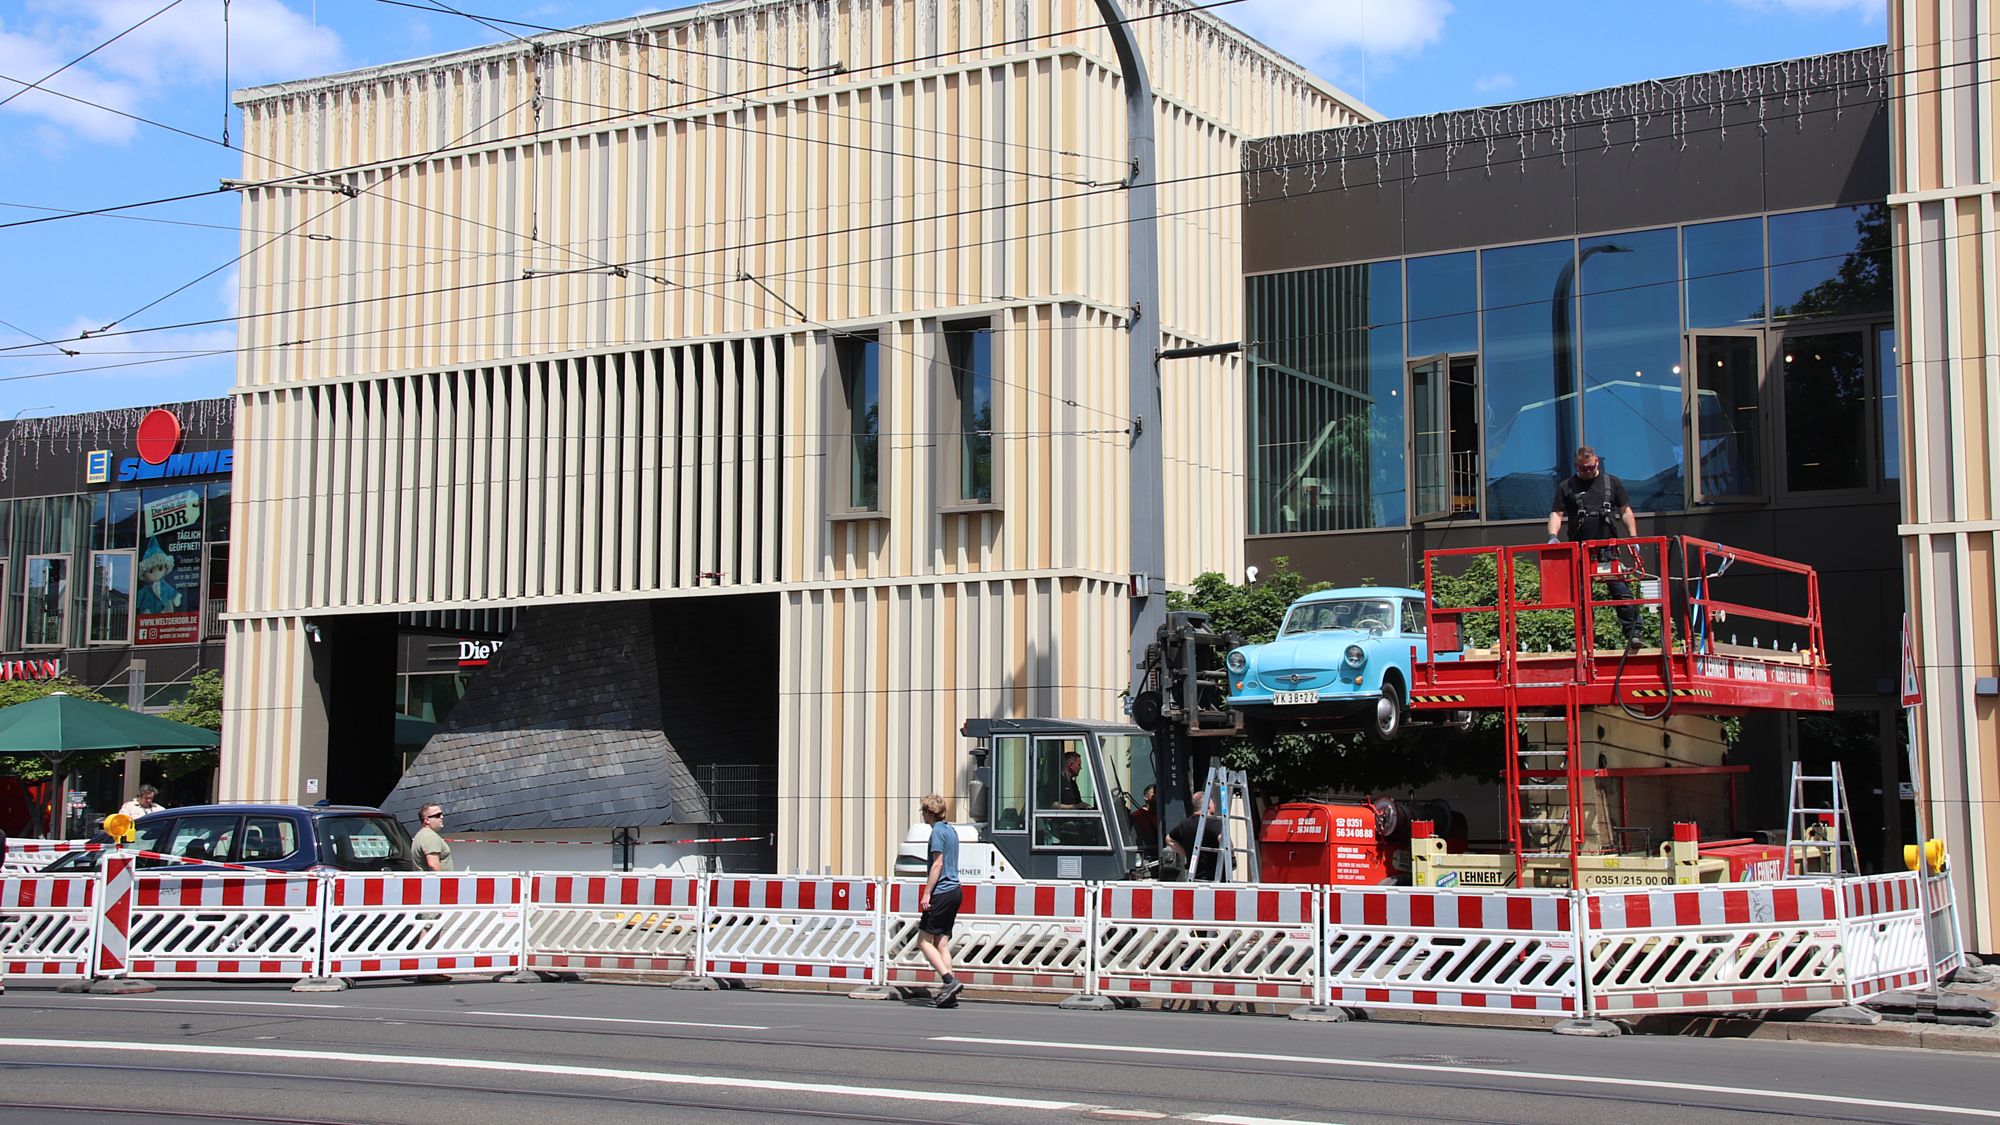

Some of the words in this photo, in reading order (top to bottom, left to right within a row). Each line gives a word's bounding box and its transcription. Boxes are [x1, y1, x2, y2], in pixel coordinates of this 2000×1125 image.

[151, 508, 162, 516] Die
[162, 502, 176, 512] Welt
[152, 510, 188, 533] DDR
[177, 530, 201, 540] TÄGLICH
[168, 541, 201, 552] GEÖFFNET!
[459, 641, 490, 659] Die
[1346, 819, 1362, 827] 0351
[1336, 829, 1345, 837] 56
[1346, 829, 1354, 837] 34
[1355, 829, 1364, 837] 08
[1364, 829, 1373, 838] 88
[1753, 860, 1780, 881] LEHNERT
[1459, 871, 1502, 883] LEHNERT
[1595, 875, 1642, 885] 0351/215
[1645, 876, 1658, 886] 00
[1661, 876, 1674, 886] 00
